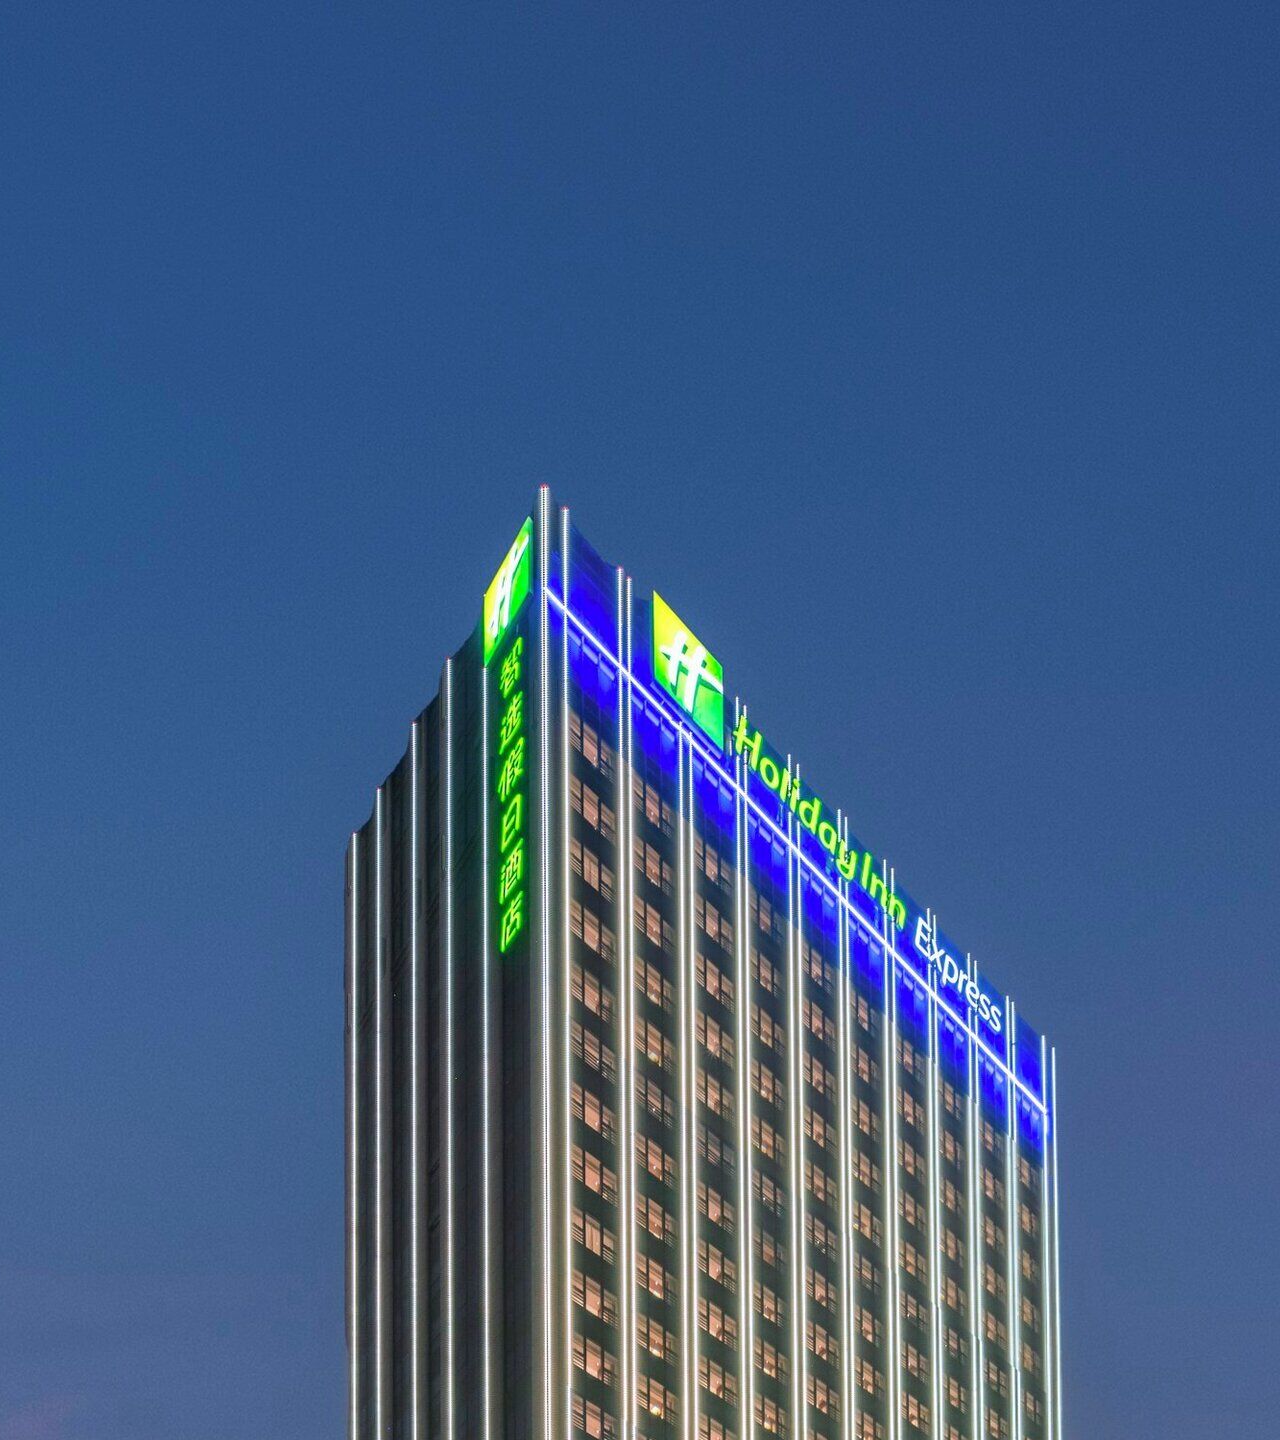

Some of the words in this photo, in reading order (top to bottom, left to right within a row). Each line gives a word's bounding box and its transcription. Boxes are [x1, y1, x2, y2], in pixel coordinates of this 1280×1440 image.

[498, 636, 524, 953] 智选假日酒店
[733, 714, 858, 882] Holiday
[860, 850, 907, 930] Inn
[914, 916, 1002, 1032] Express
